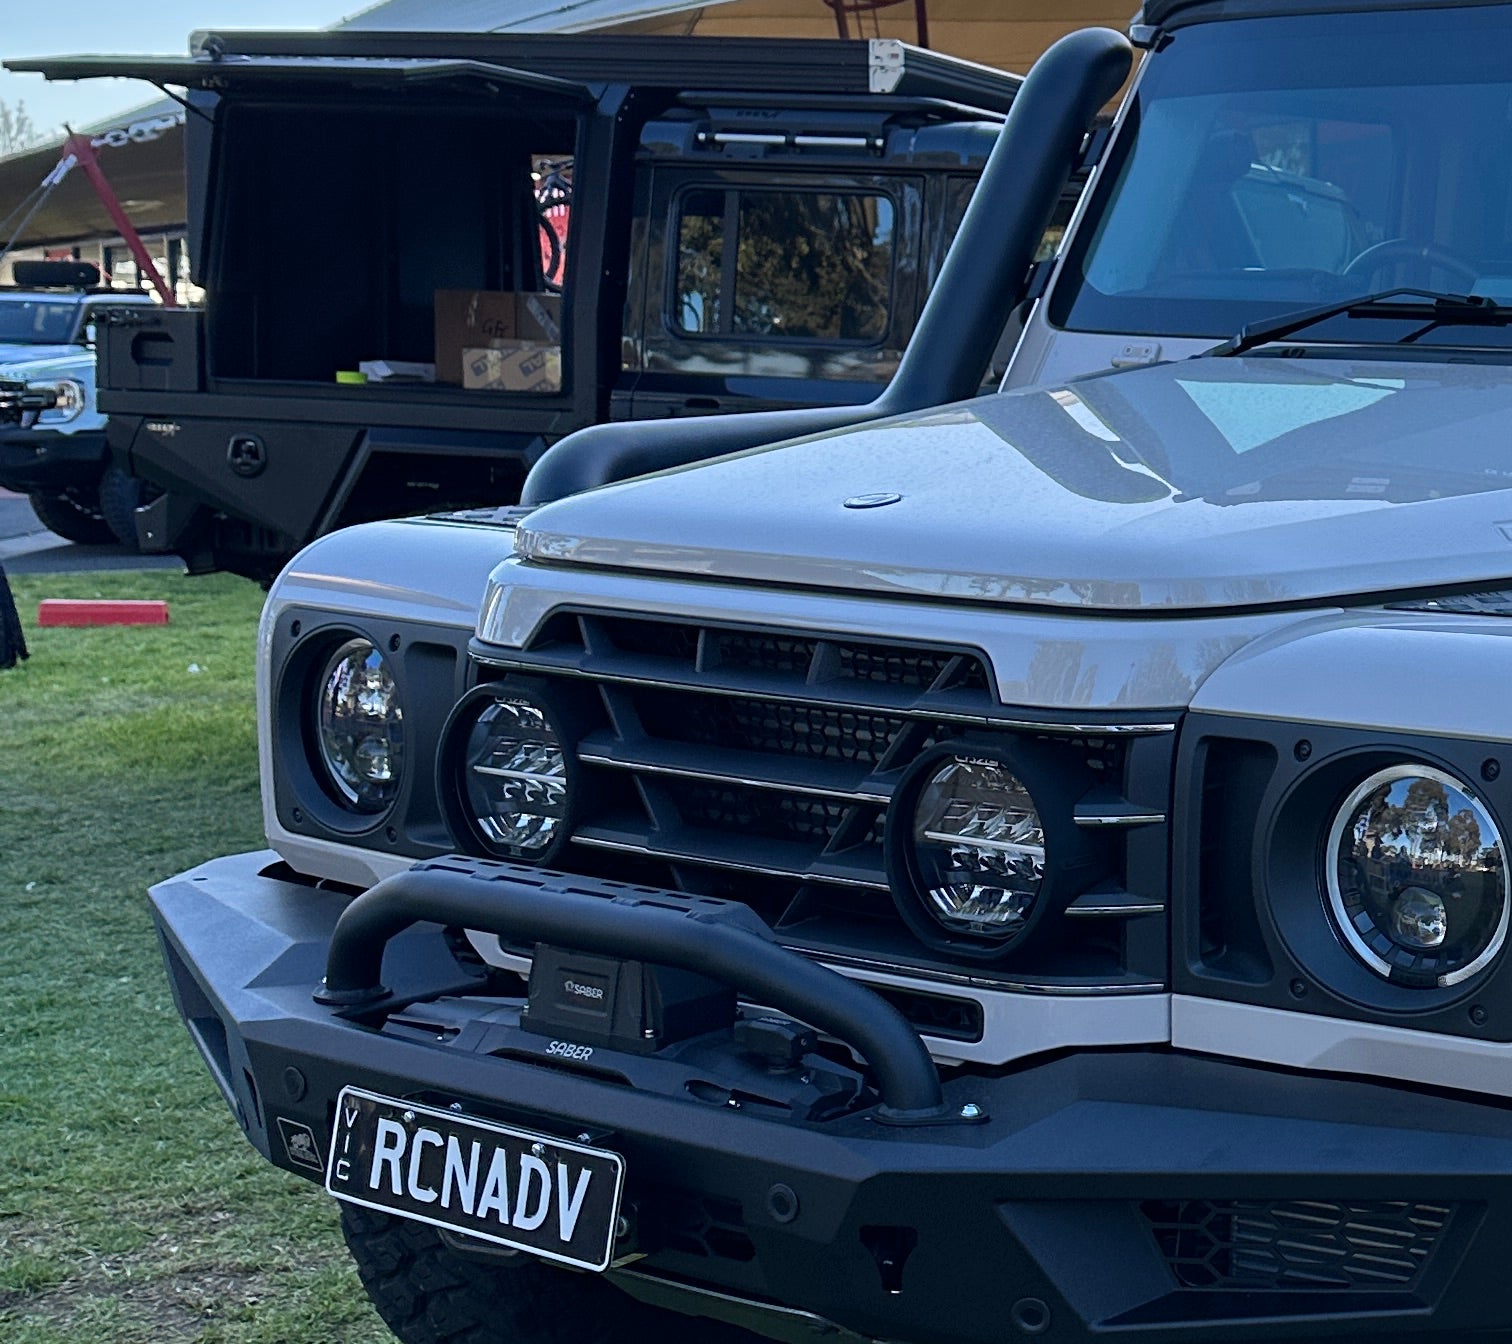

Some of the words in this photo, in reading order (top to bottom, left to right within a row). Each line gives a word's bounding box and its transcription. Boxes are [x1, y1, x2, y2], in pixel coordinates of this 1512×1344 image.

[573, 982, 604, 1000] SABER
[545, 1040, 593, 1062] SABER
[369, 1117, 593, 1243] RCNADV
